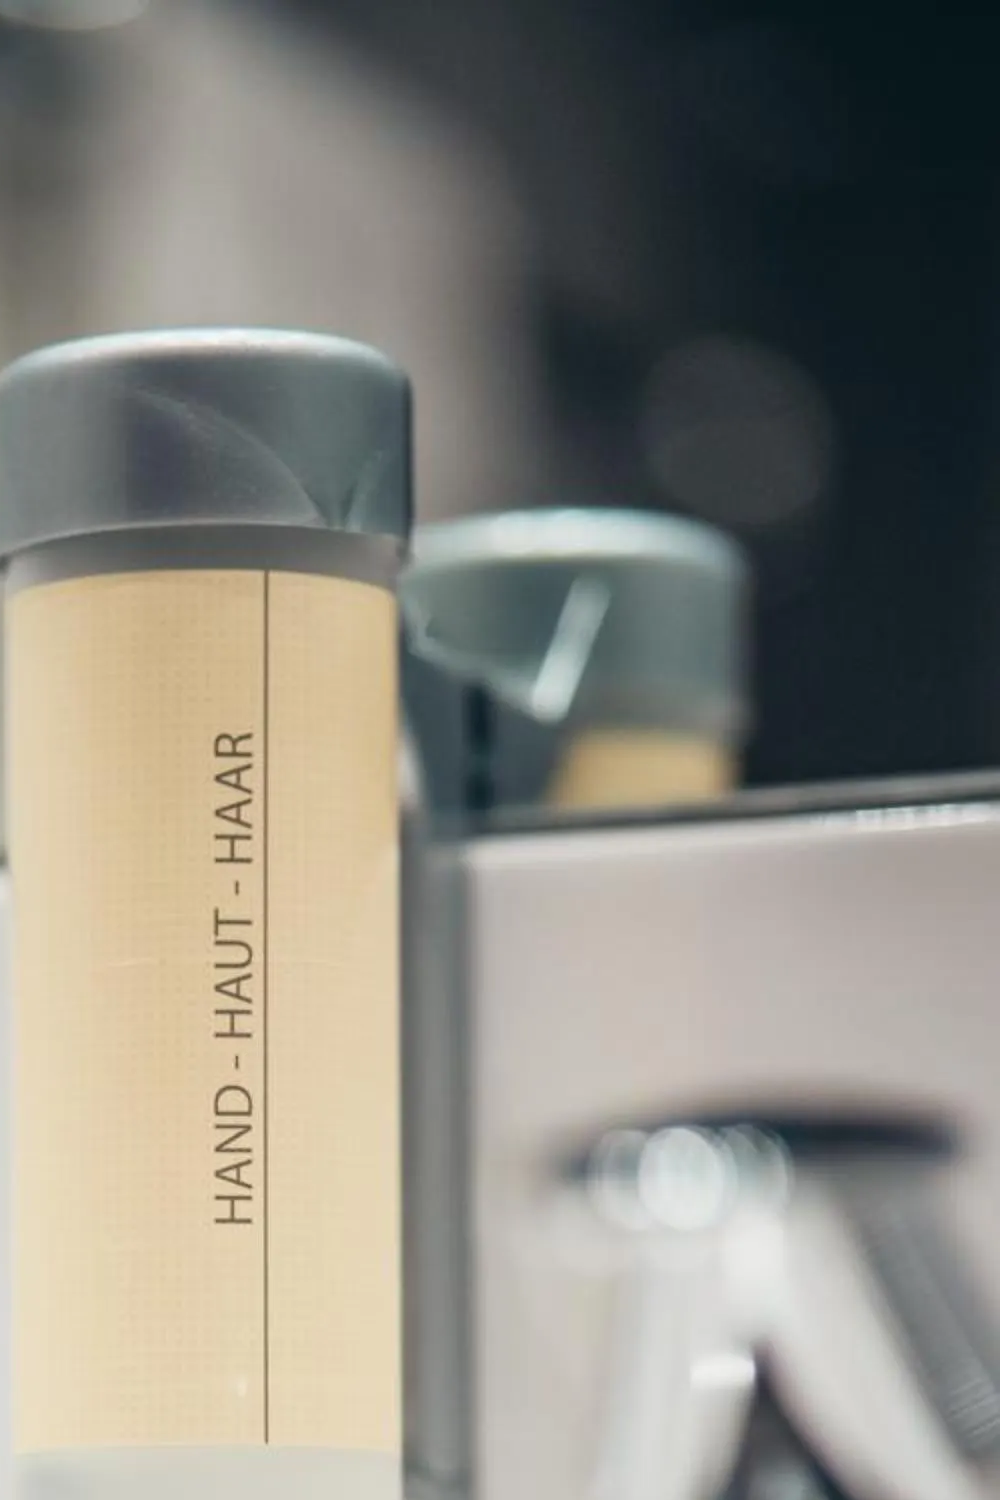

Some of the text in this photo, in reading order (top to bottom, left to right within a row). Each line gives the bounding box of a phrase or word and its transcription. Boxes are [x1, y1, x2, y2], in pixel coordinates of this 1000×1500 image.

[213, 731, 253, 865] HAAR
[213, 907, 253, 1040] HAUT
[213, 1084, 253, 1225] HAND
